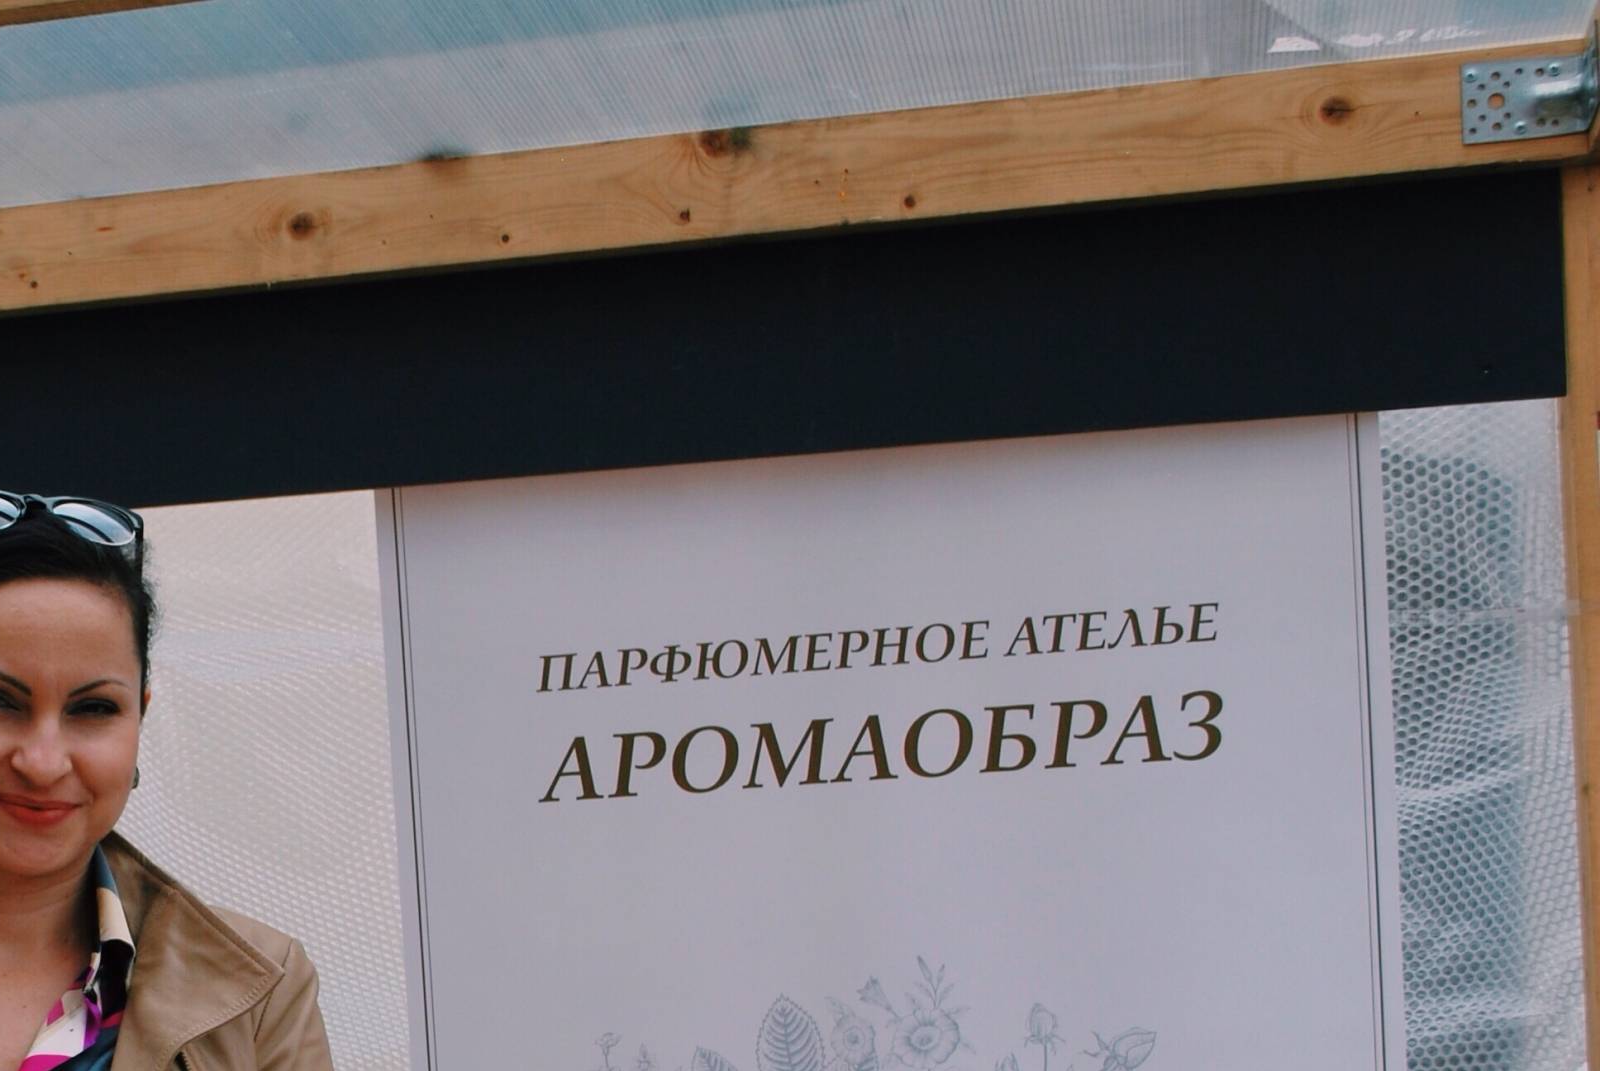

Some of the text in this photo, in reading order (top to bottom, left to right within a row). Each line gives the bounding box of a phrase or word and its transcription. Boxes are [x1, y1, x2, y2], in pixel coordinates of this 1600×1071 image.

[535, 600, 1220, 694] ПАРФЮМЕРНОЕ АТЕЛЬЕ
[538, 688, 1224, 804] АРОМАОБРАЗ
